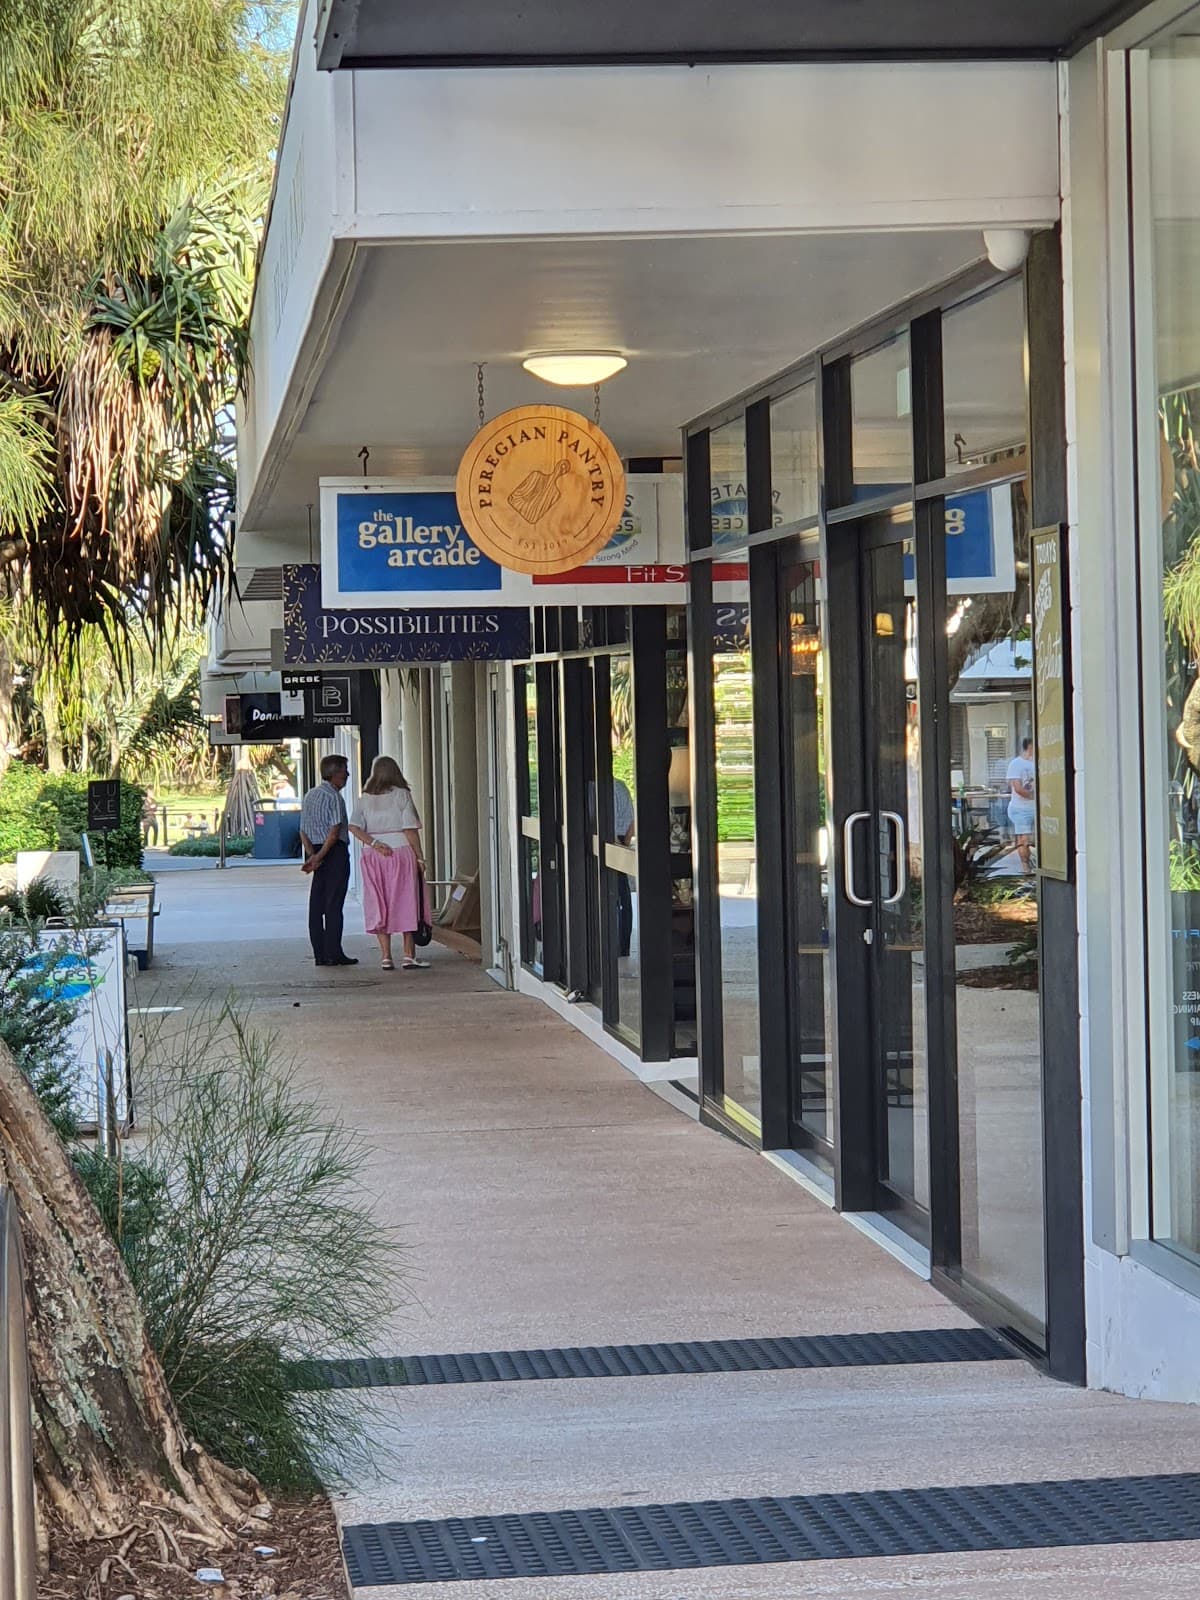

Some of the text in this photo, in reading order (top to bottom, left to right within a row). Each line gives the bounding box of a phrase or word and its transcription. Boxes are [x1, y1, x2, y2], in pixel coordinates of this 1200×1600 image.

[478, 426, 605, 509] PEREGIAN PANTRY
[373, 509, 394, 521] the
[358, 516, 461, 549] gallery
[387, 540, 480, 567] arcade
[624, 565, 657, 582] Fit
[314, 614, 500, 638] POSSIBILITIES
